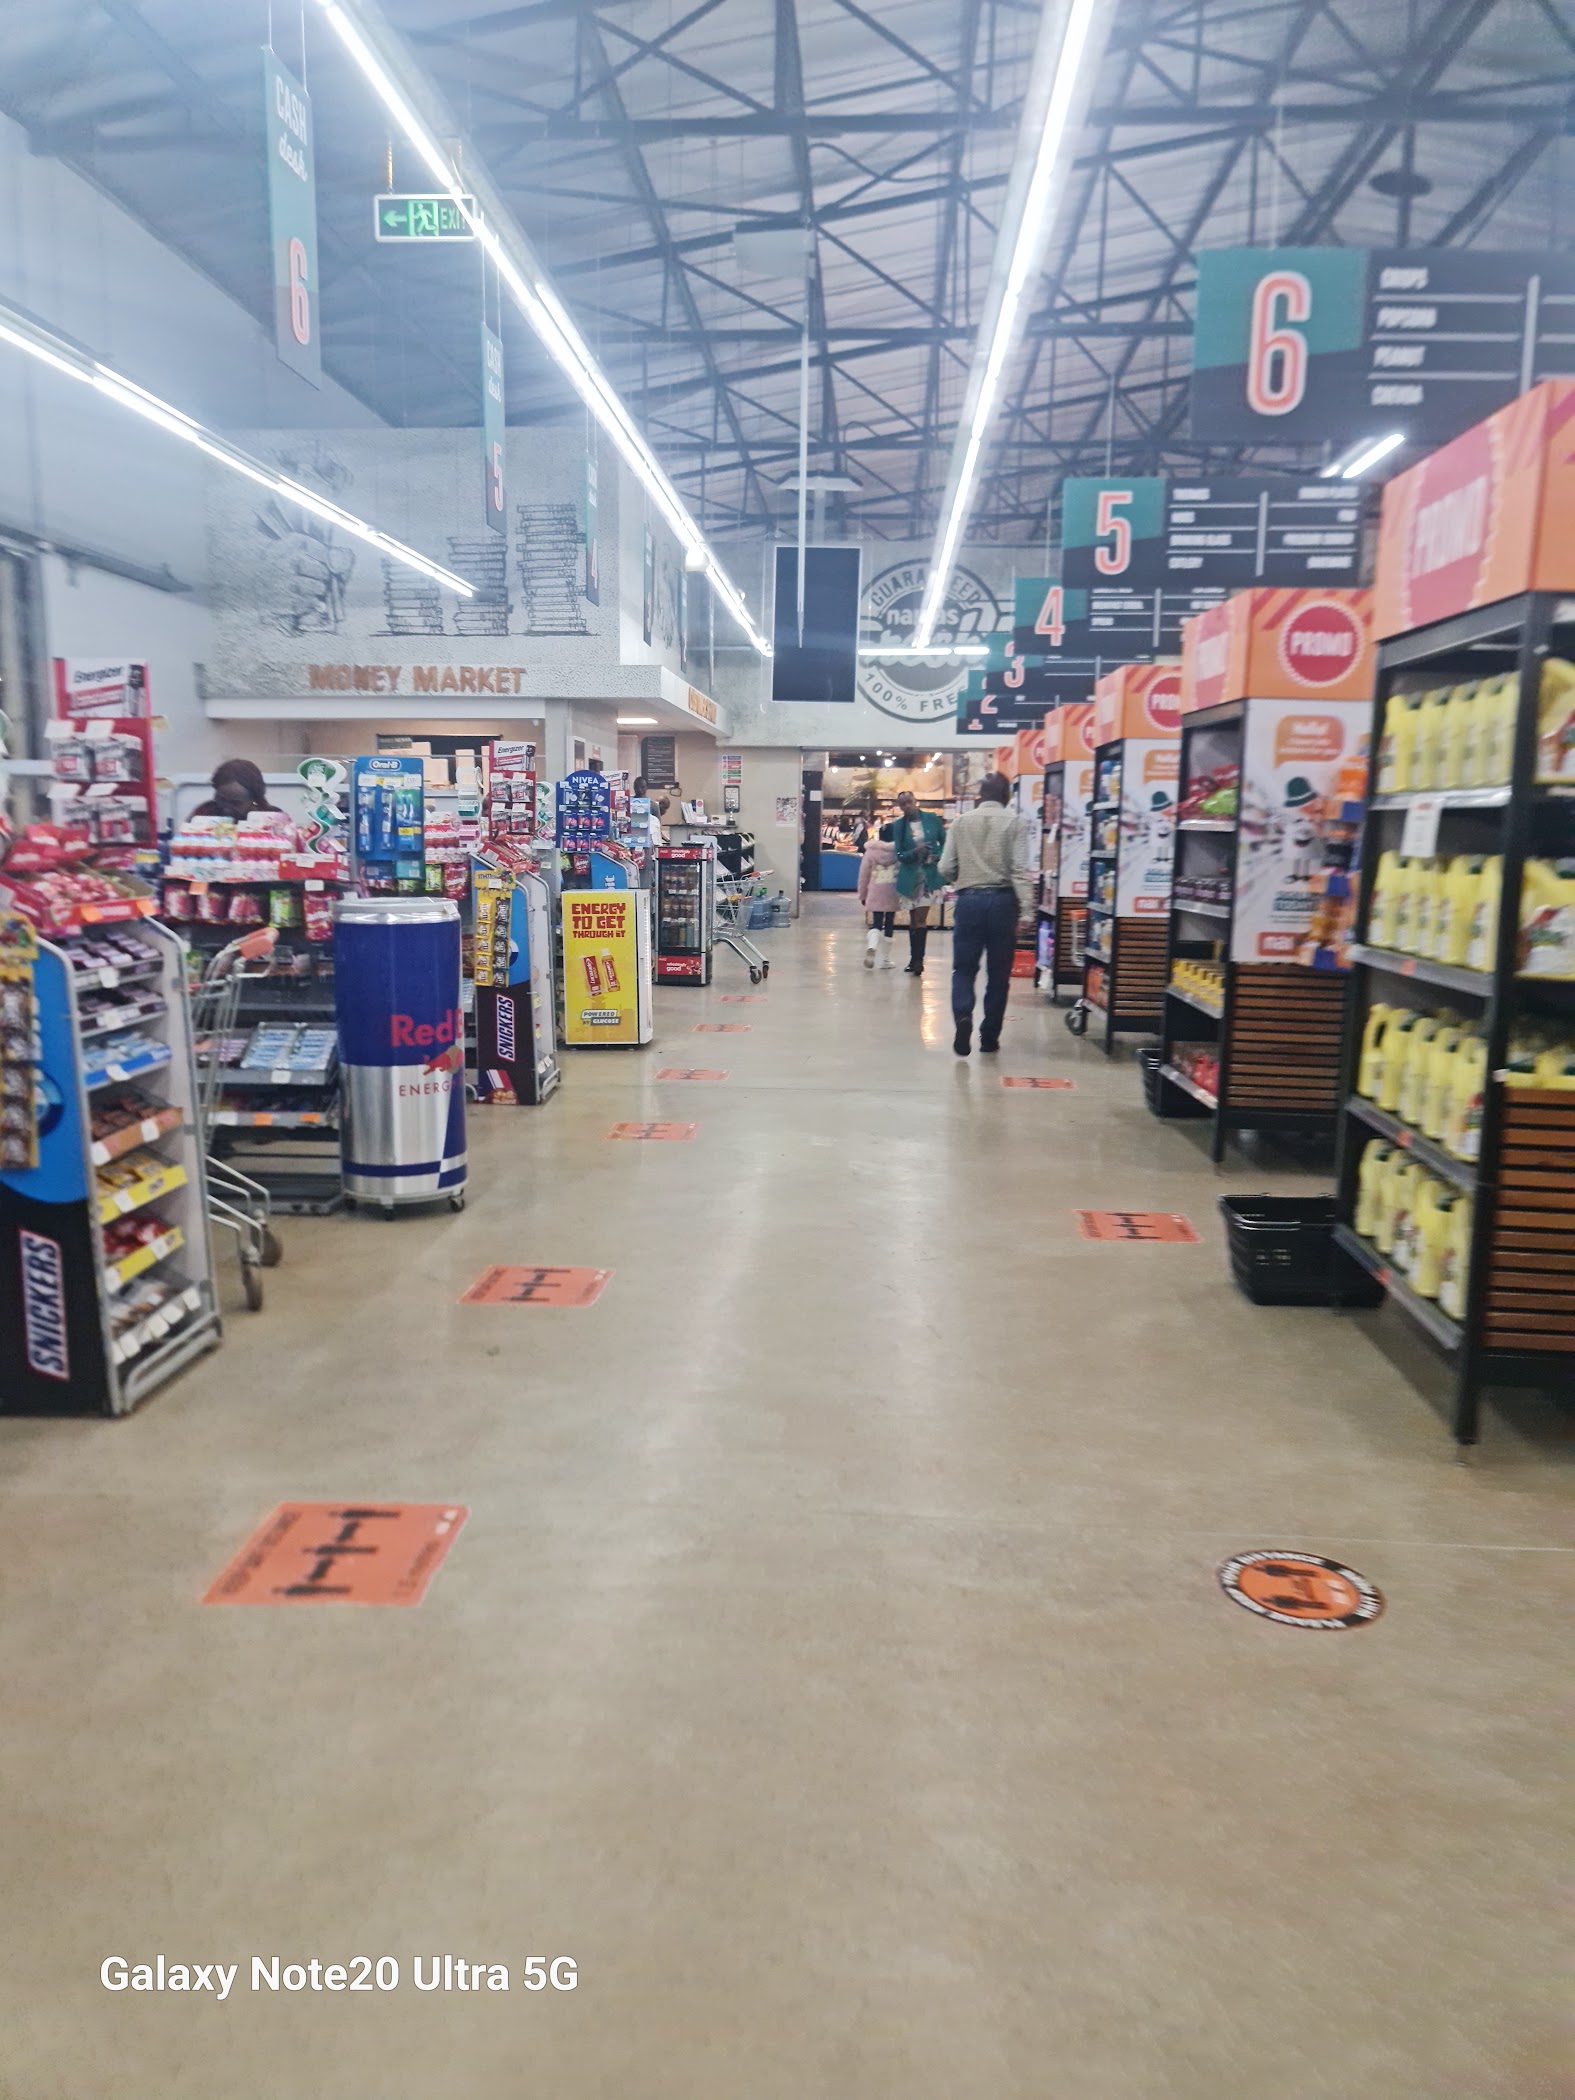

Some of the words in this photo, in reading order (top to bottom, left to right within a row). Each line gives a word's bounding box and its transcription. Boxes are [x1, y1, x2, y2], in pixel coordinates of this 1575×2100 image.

[275, 75, 308, 146] CASH
[279, 131, 308, 182] desk
[289, 237, 310, 345] 6
[1246, 269, 1313, 417] 6
[493, 441, 504, 512] 5
[1094, 490, 1134, 576] 5
[870, 568, 982, 608] GUARAEED
[1034, 586, 1066, 647] 4
[307, 663, 402, 692] MONEY
[412, 665, 527, 694] MARKET
[1003, 640, 1025, 688] 3
[864, 673, 908, 711] 100%
[919, 692, 958, 712] FRE
[372, 760, 399, 769] Oral-B
[497, 745, 525, 754] Energizer
[572, 776, 599, 785] NIVEA
[571, 902, 627, 915] ENERGY
[572, 915, 593, 930] TO
[595, 915, 626, 930] GET
[572, 930, 614, 939] THROUGH
[391, 1008, 453, 1048] Red
[497, 996, 515, 1061] SNICKERS
[25, 1235, 64, 1373] SNICKERS
